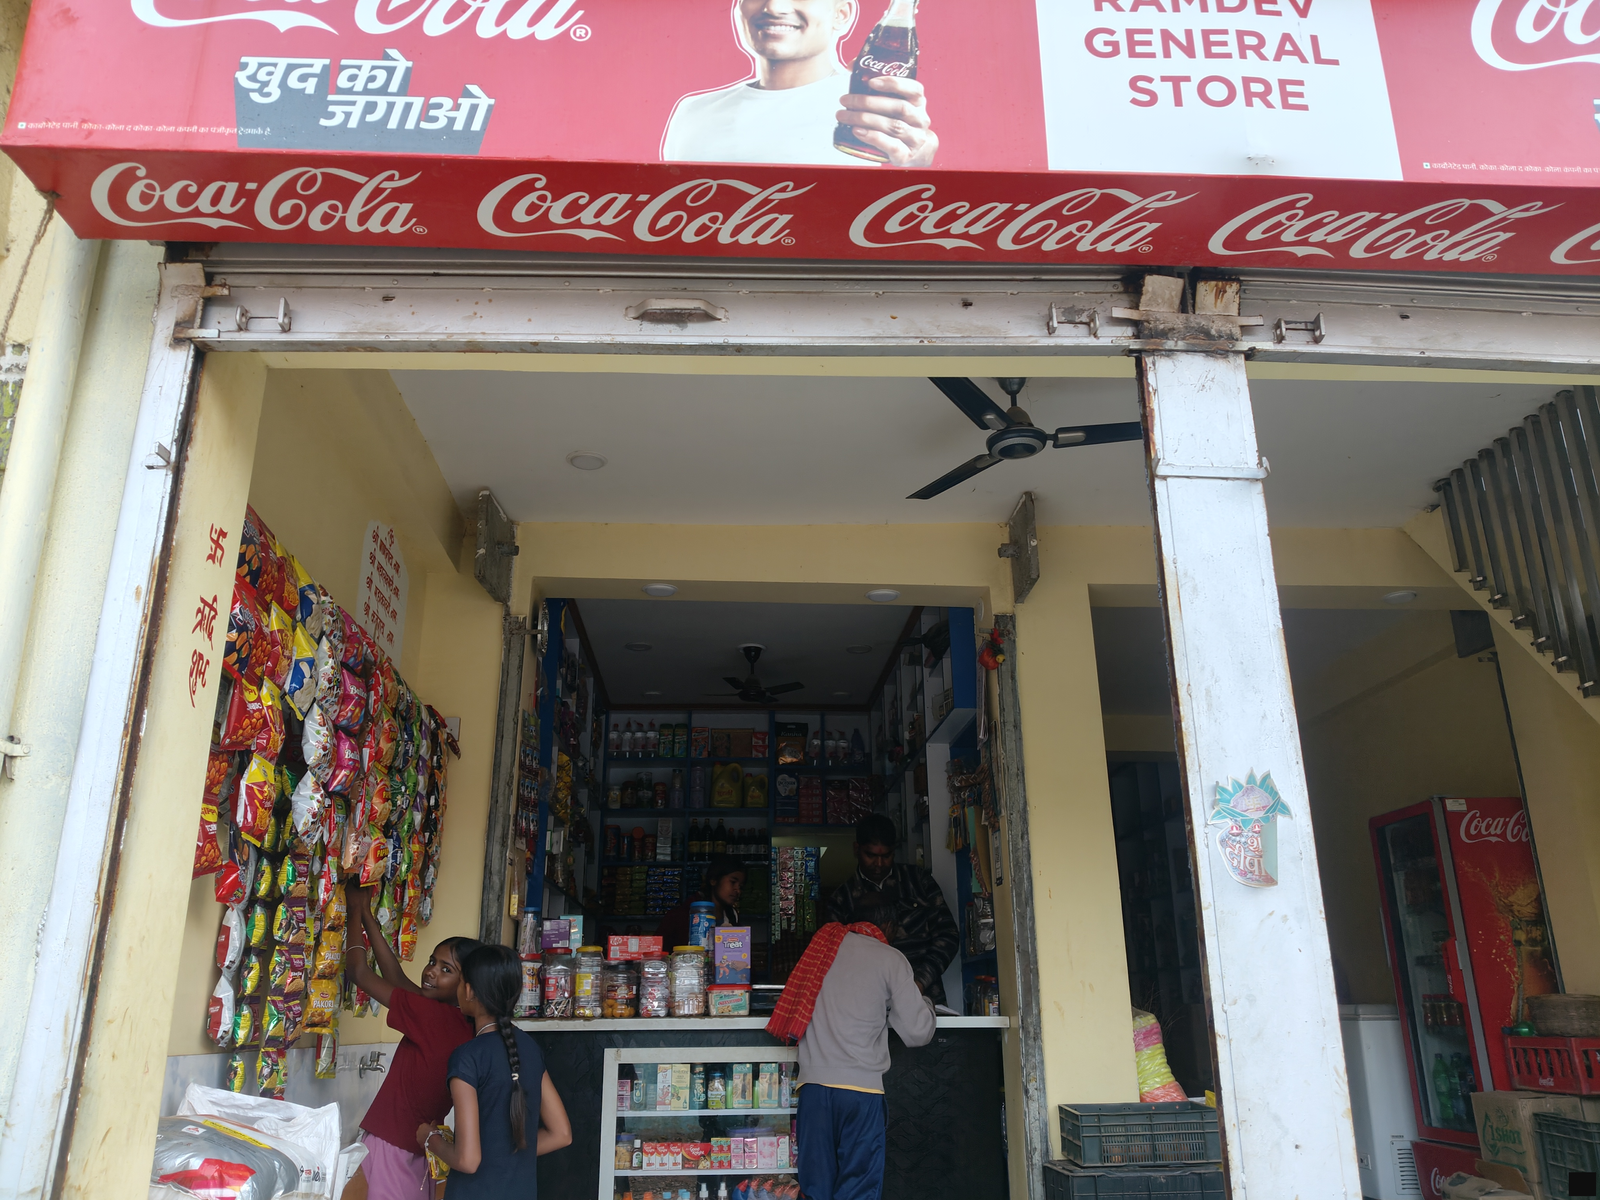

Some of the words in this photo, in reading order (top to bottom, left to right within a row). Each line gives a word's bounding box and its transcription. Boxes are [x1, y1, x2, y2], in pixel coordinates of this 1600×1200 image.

[235, 56, 331, 104] खुद
[336, 48, 413, 93] को
[1084, 27, 1340, 66] GENERAL
[318, 84, 496, 131] जगाओ
[1128, 75, 1310, 111] STORE
[90, 161, 422, 234] Coca-Cola
[477, 173, 817, 246] Coca-Cola
[849, 184, 1200, 253] Coca-Cola
[1208, 193, 1566, 262] Coca-Cola
